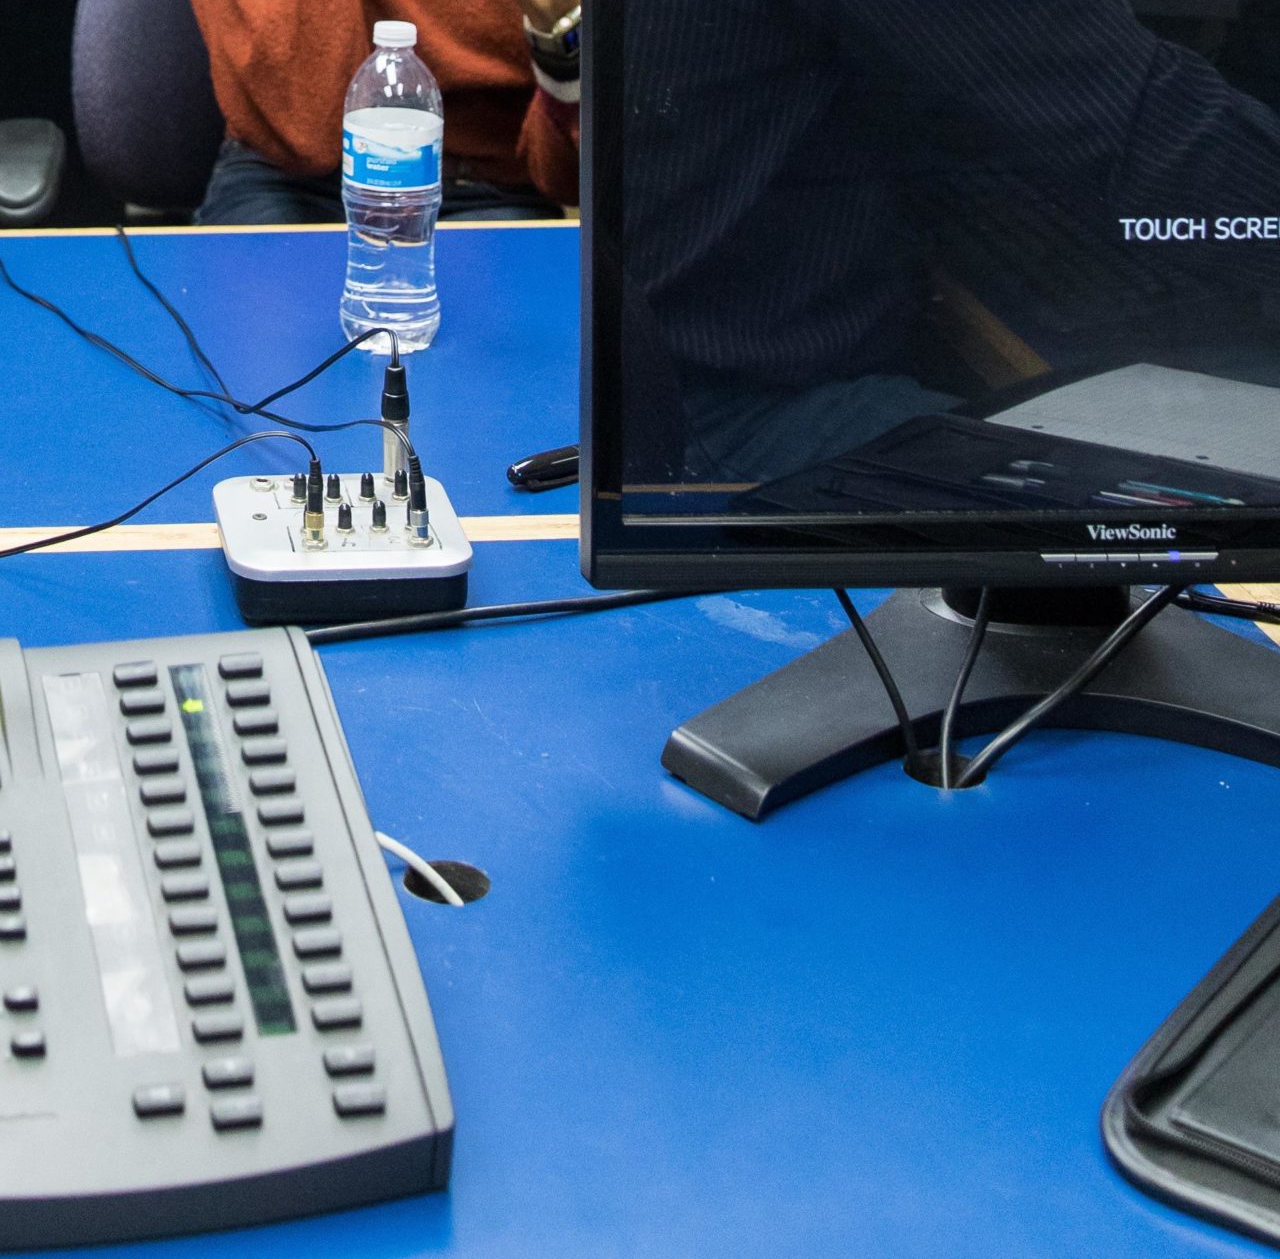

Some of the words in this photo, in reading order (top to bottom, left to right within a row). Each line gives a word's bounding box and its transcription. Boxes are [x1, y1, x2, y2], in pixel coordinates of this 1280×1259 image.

[1119, 217, 1206, 240] TOUCH
[1214, 217, 1280, 239] SCRE
[1087, 523, 1177, 540] ViewSonic
